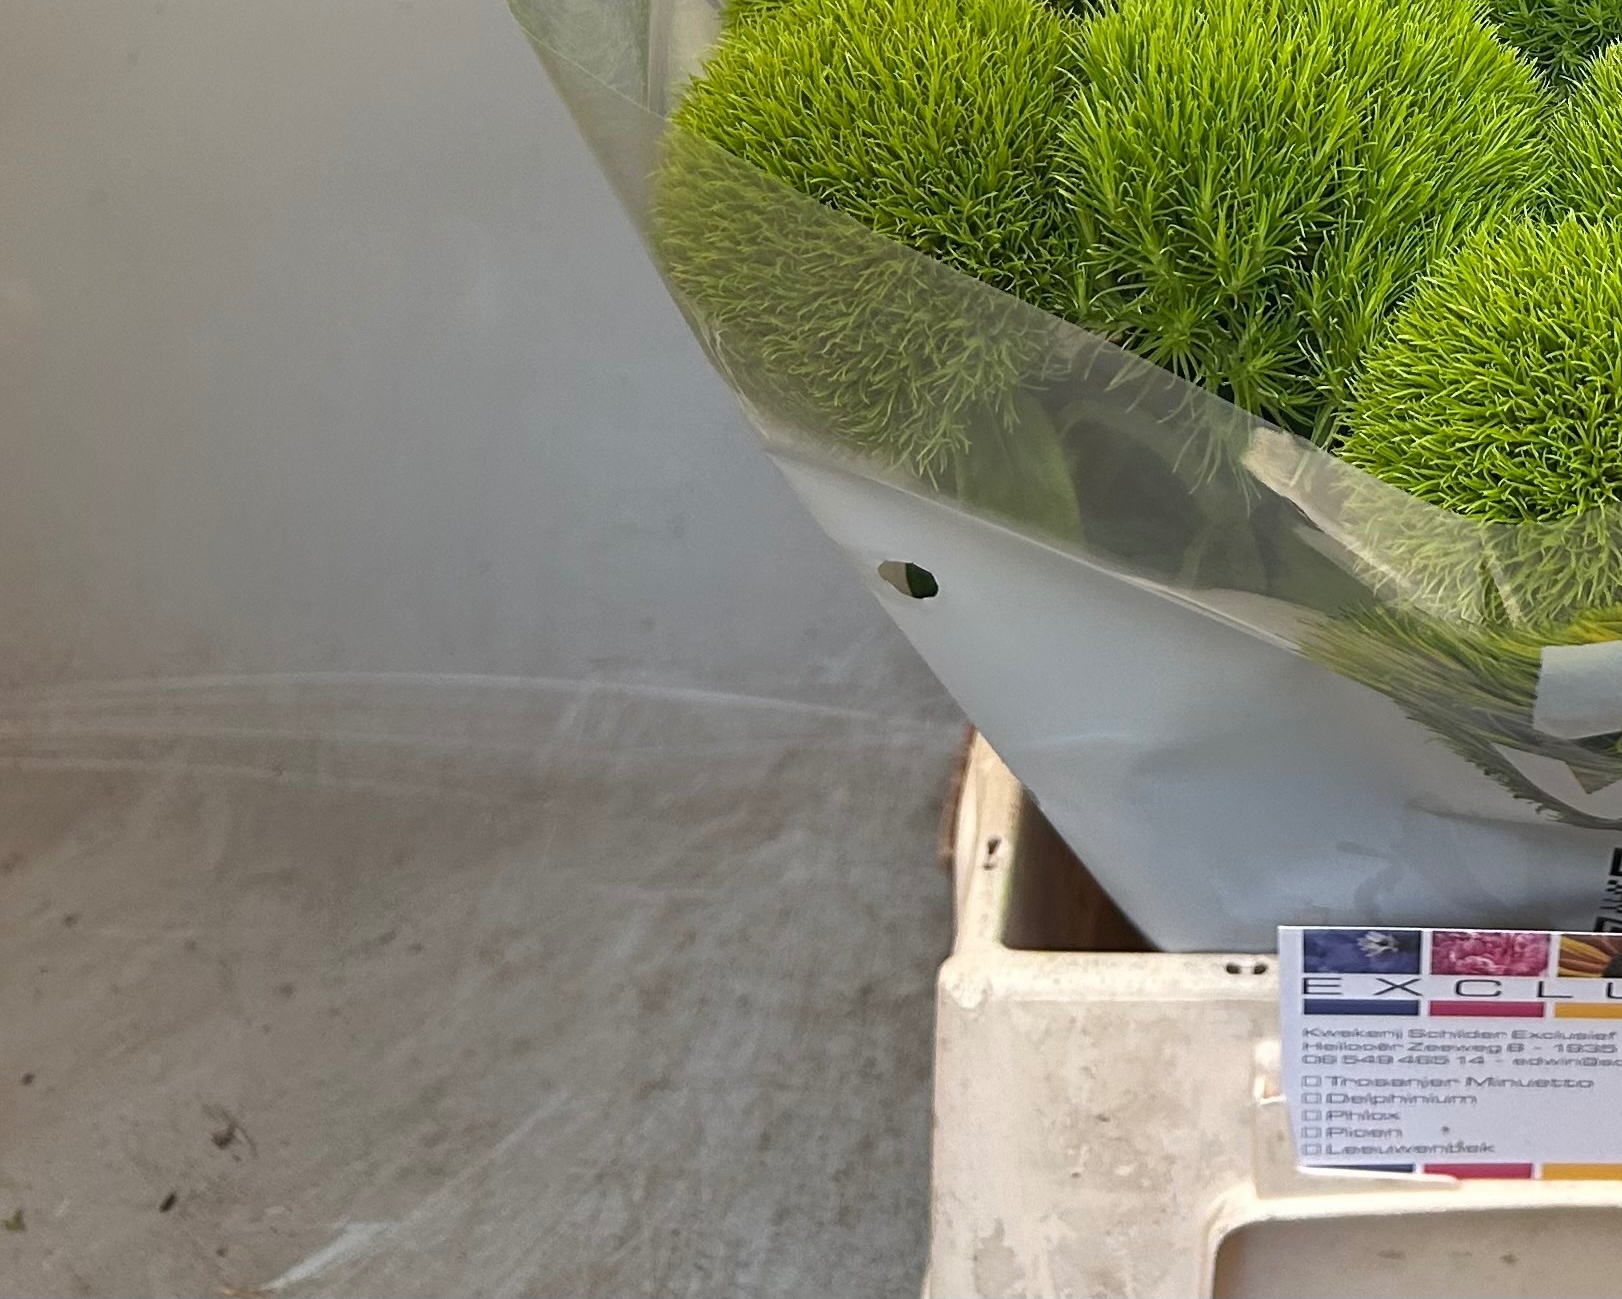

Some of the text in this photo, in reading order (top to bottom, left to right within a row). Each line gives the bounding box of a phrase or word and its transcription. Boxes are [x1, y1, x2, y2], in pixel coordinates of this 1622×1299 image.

[1302, 1028, 1617, 1041] Kwekerij Schilder Exclusief
[1464, 1076, 1595, 1089] Minuetto
[1325, 1092, 1478, 1106] Delphinium
[1325, 1109, 1401, 1122] Phlox
